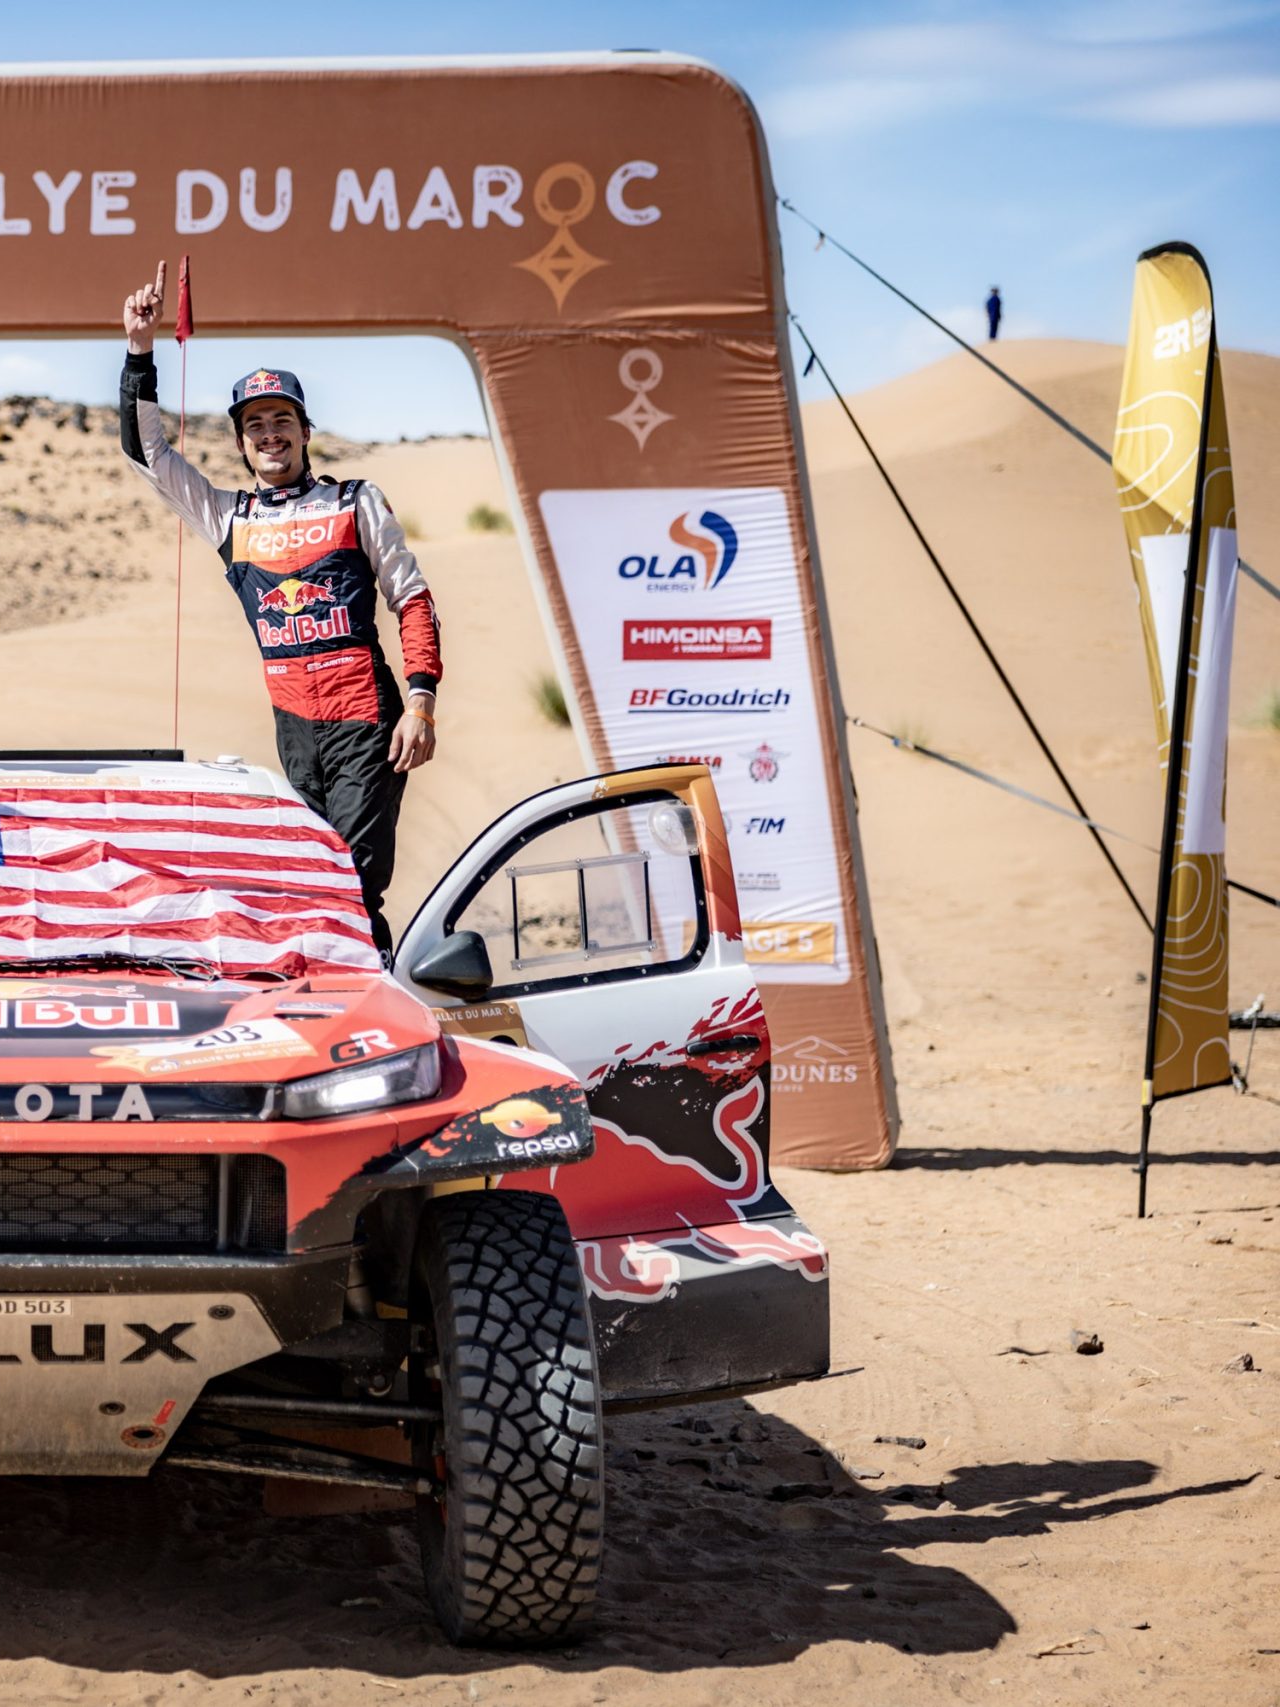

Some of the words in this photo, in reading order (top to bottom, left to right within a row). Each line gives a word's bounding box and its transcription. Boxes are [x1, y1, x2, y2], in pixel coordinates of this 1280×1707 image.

[175, 166, 292, 235] DU
[329, 160, 661, 232] MAROC
[247, 518, 336, 558] repsol
[618, 555, 697, 579] OLA
[646, 583, 696, 593] ENERGY
[256, 615, 298, 648] Red
[295, 605, 352, 645] Bull
[630, 626, 764, 645] HIMOINSA
[629, 688, 790, 707] BFGoodrich
[745, 817, 785, 835] FIM
[798, 930, 814, 953] 5
[13, 999, 181, 1031] Bull
[435, 1011, 463, 1022] ALLYE
[465, 1009, 479, 1019] DU
[329, 1029, 397, 1064] GR
[770, 1064, 858, 1083] DUNES
[495, 1130, 579, 1158] repsol
[24, 1300, 65, 1315] 503
